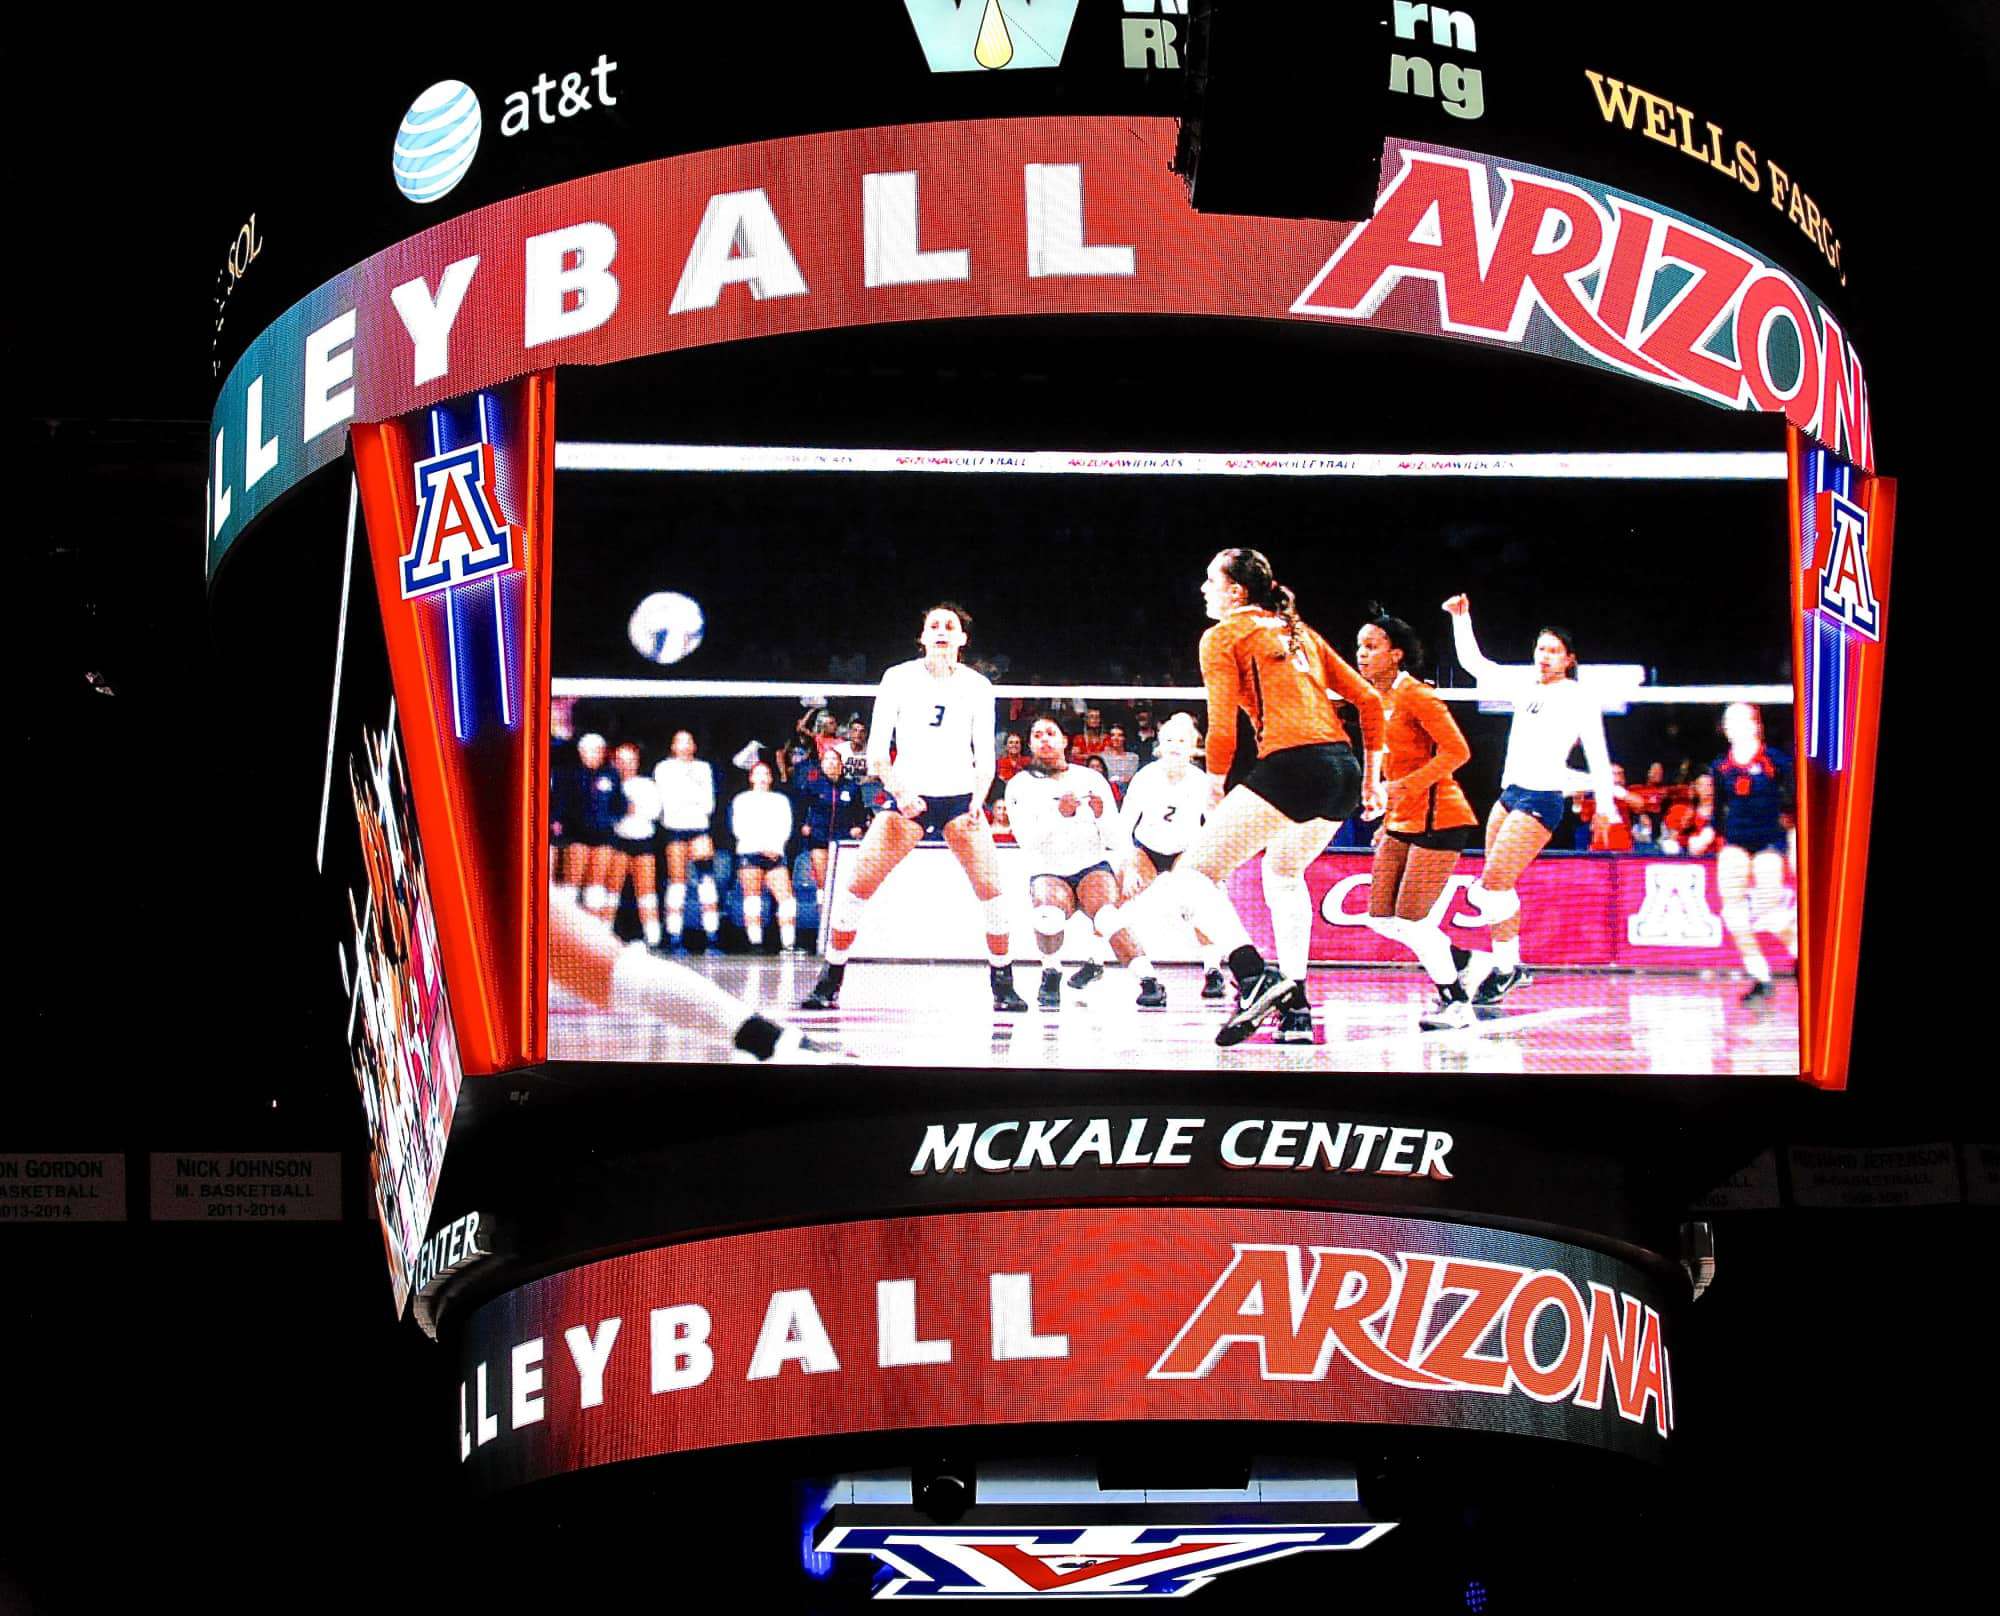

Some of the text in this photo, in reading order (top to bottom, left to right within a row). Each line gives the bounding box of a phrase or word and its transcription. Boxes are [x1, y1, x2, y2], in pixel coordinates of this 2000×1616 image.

[500, 54, 618, 137] at&t
[1585, 69, 1760, 192] WELLS
[206, 148, 1875, 581] LLEYBALL ARIZON
[929, 705, 945, 727] 3
[1163, 806, 1175, 822] 2
[25, 1159, 103, 1178] GORDON
[176, 1158, 312, 1178] NICK JOHNSON
[910, 1118, 1455, 1180] MCKALE CENTER
[200, 1184, 314, 1198] BASKETBALL
[207, 1203, 287, 1217] 2011-2014
[414, 1211, 481, 1296] ENTER
[1146, 1243, 1668, 1439] ARIZONA
